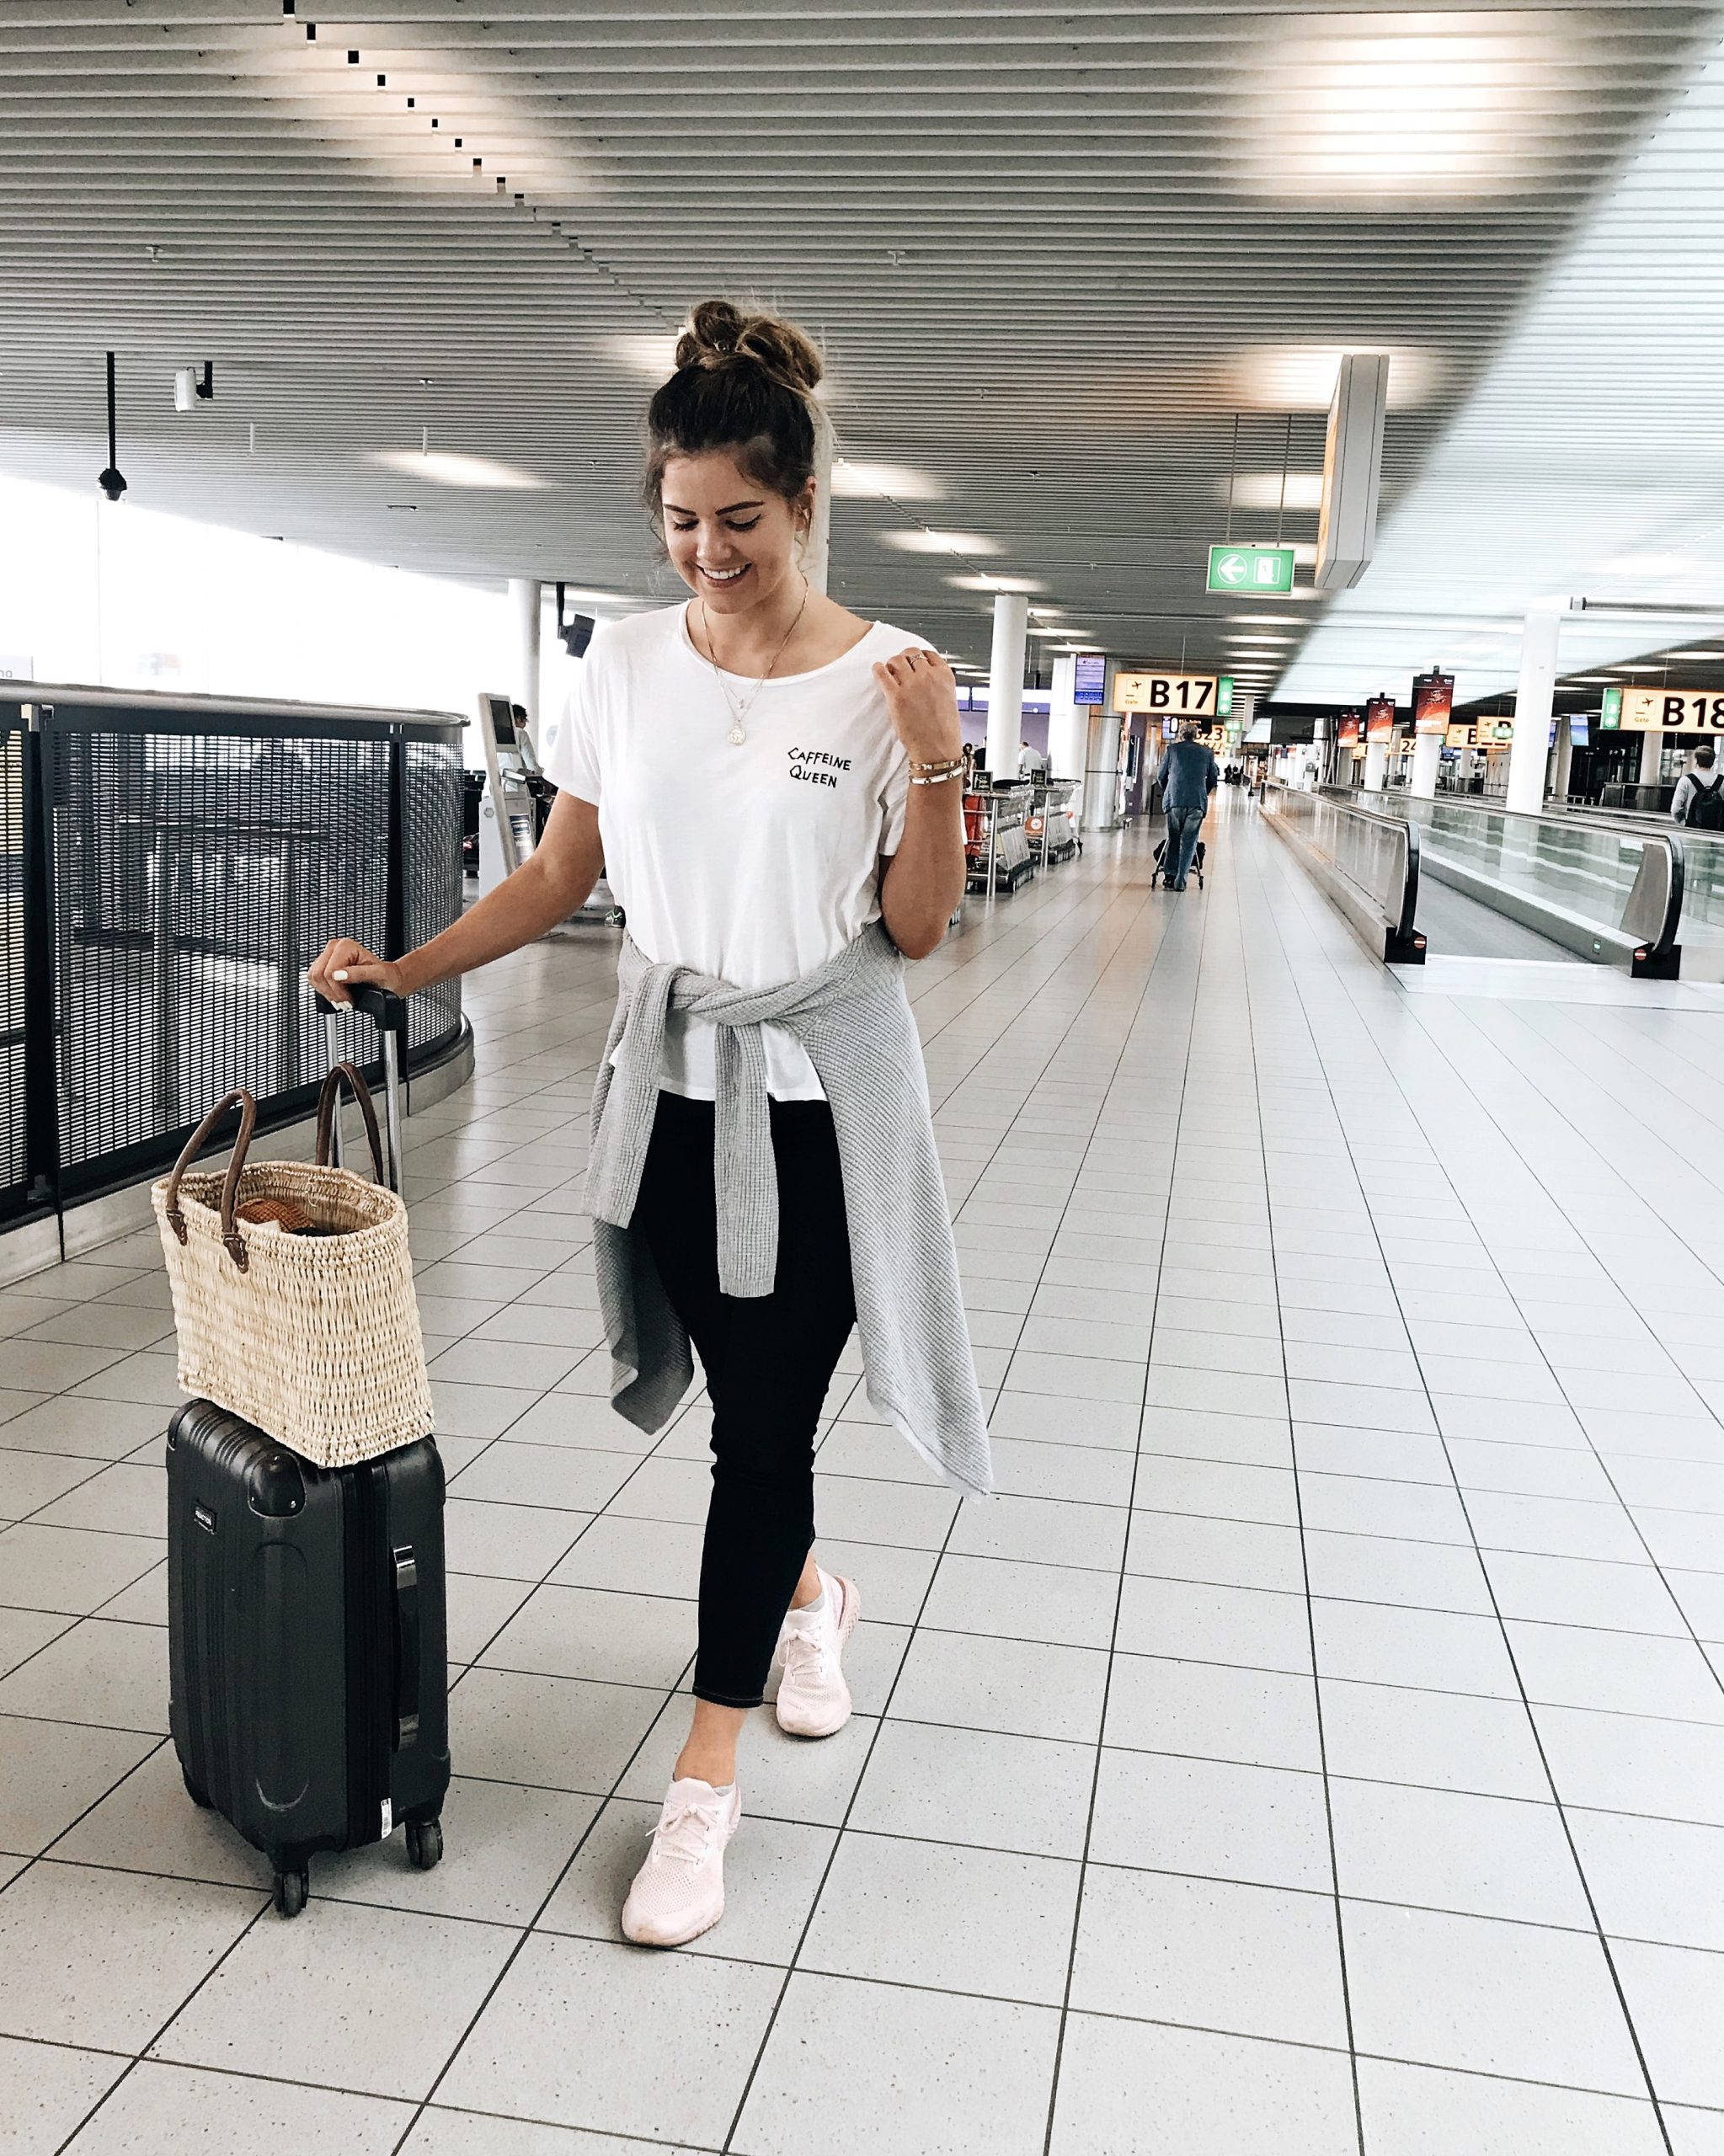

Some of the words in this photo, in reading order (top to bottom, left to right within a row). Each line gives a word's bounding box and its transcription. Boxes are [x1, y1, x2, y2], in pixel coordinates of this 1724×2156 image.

[1150, 680, 1213, 709] B17
[1662, 696, 1724, 728] B18
[787, 747, 851, 770] CAFFEINE
[789, 765, 837, 788] QUEEN
